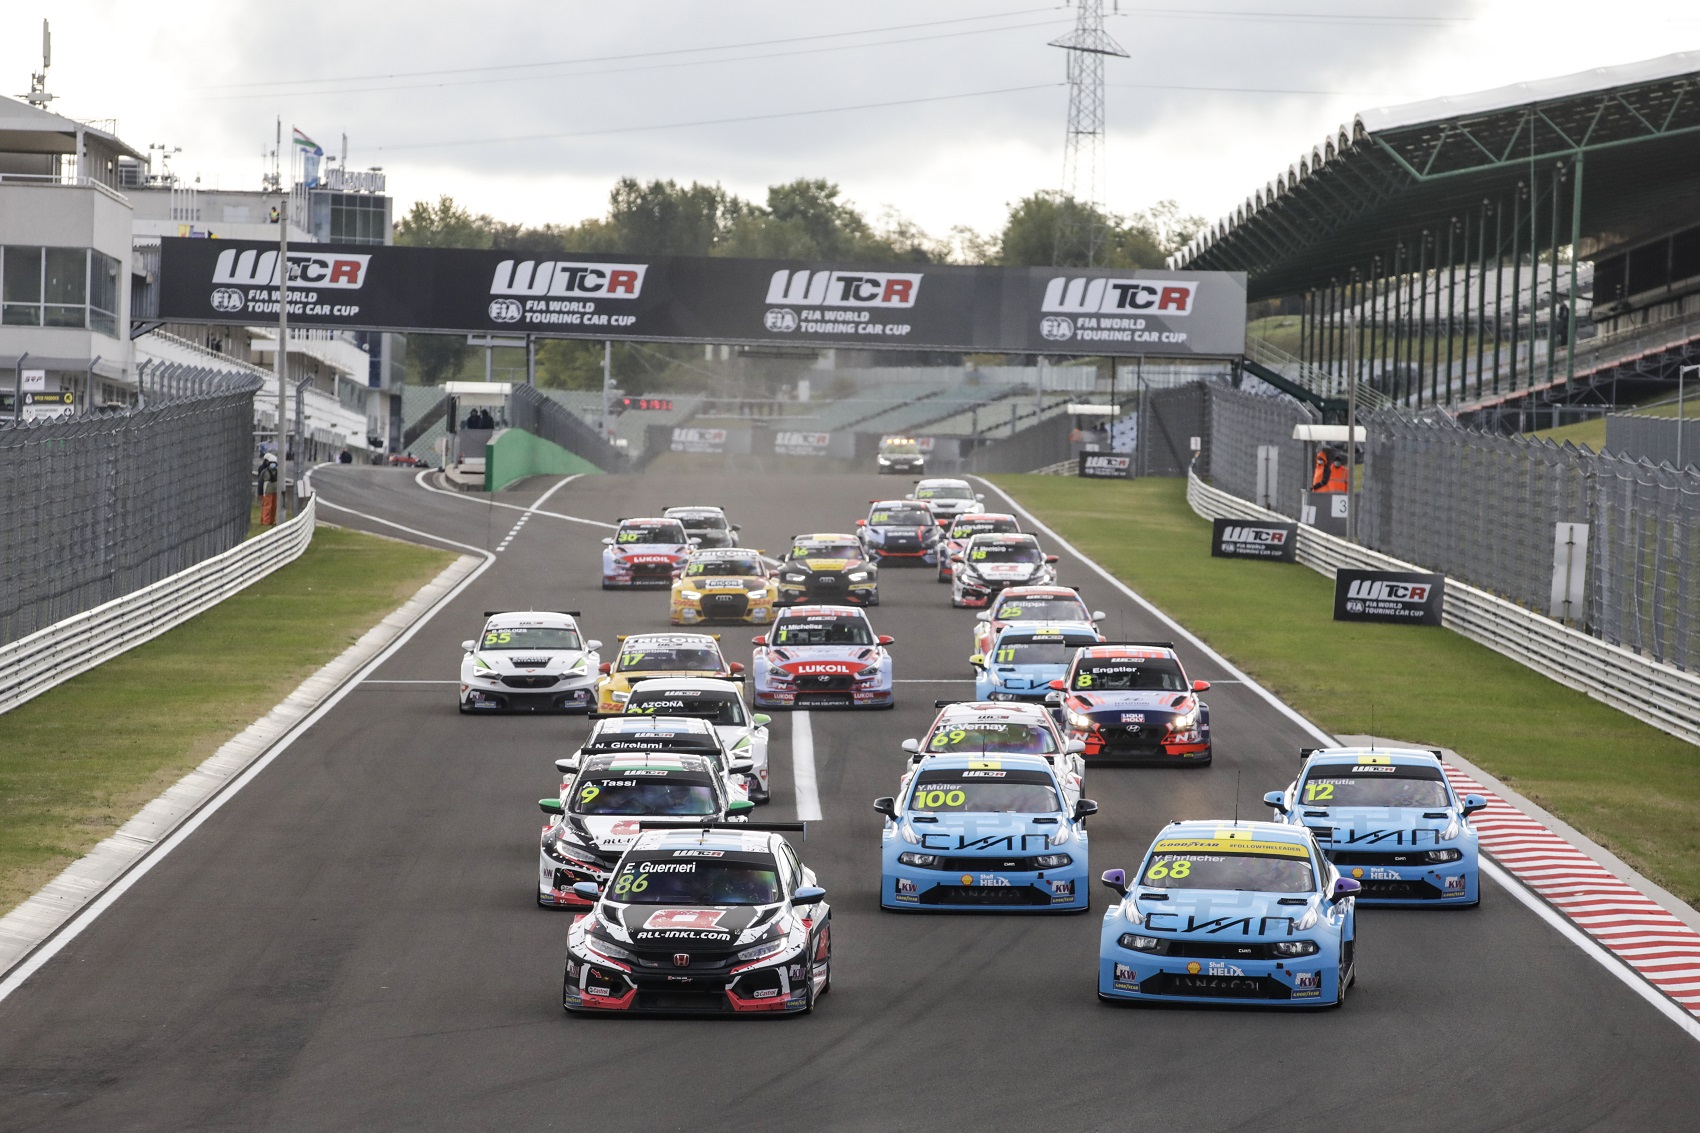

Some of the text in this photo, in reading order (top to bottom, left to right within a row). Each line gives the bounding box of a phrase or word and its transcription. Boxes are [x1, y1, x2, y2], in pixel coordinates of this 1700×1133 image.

[212, 248, 372, 289] WTCR
[489, 259, 648, 299] WTCR
[765, 269, 924, 307] WTCR
[211, 289, 245, 311] FIA
[248, 290, 317, 303] FIA WORLD
[1041, 277, 1200, 315] WTCR
[247, 302, 359, 317] TOURNG CAR CUP
[489, 299, 522, 323] FIA
[525, 300, 595, 313] FIA WORLD
[525, 312, 636, 327] TOURING CAR CUP
[801, 309, 870, 323] FIA WORLD
[800, 321, 911, 336] TOURING CAR CUP
[1077, 317, 1146, 330] FIA WORLD
[1076, 329, 1187, 343] TOURING CAR CUP
[1339, 499, 1347, 514] 3
[618, 534, 638, 542] 30
[1222, 526, 1288, 545] WTCR
[793, 546, 808, 557] 16
[971, 551, 987, 560] 18
[687, 564, 704, 573] 31
[1347, 579, 1432, 603] WTCR
[1000, 607, 1022, 618] 25
[1365, 607, 1395, 615] TOURING
[485, 633, 511, 644] 55
[779, 631, 788, 641] 1
[622, 654, 645, 665] 17
[997, 650, 1015, 662] 11
[798, 665, 849, 673] LUKOIL
[1077, 675, 1092, 687] 8
[932, 731, 966, 746] 69
[1074, 732, 1088, 741] N
[1175, 732, 1189, 742] N
[583, 779, 636, 789] A. Tassi
[581, 787, 600, 803] 9
[1305, 784, 1334, 800] 12
[915, 790, 966, 808] 100
[1229, 843, 1301, 852] #FOLLOWTHELEADER
[622, 862, 696, 874] E. Guerrieri
[1147, 861, 1191, 880] 68
[1370, 872, 1401, 880] HELIX
[615, 874, 648, 894] 86
[902, 883, 918, 893] KW
[980, 878, 1011, 887] HELIX
[1055, 884, 1071, 894] KW
[1120, 970, 1136, 980] KW
[1208, 967, 1244, 976] HELIX
[1299, 977, 1319, 987] KW
